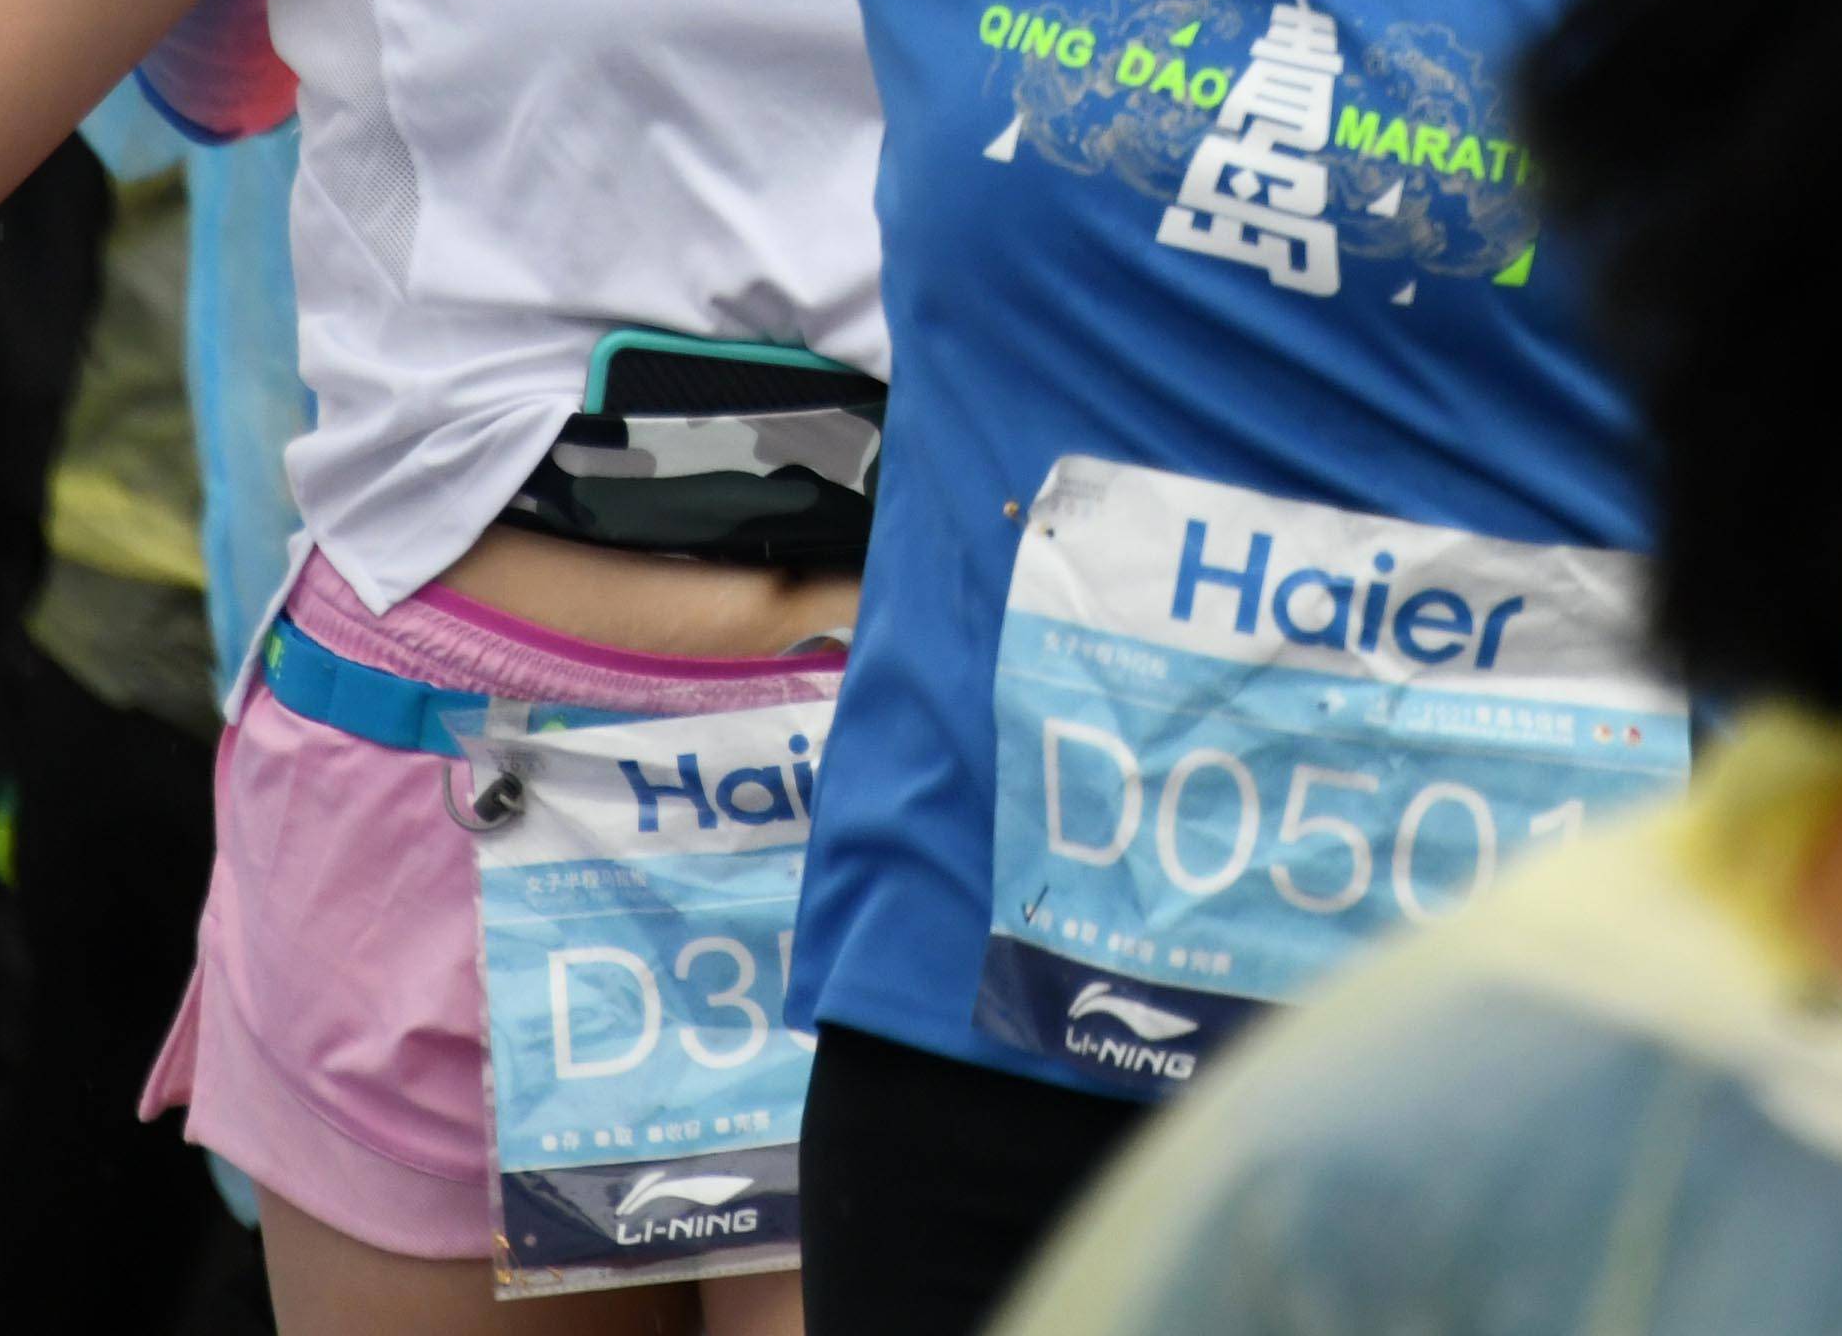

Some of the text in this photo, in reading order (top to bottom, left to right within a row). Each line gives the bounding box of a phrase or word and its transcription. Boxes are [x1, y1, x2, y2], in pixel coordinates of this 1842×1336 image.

[979, 3, 1531, 187] QING DAO MARATH
[1170, 518, 1525, 672] Haier
[617, 733, 814, 833] Hai
[1064, 1026, 1197, 1080] LI-NING
[615, 1208, 759, 1247] LI-NING
